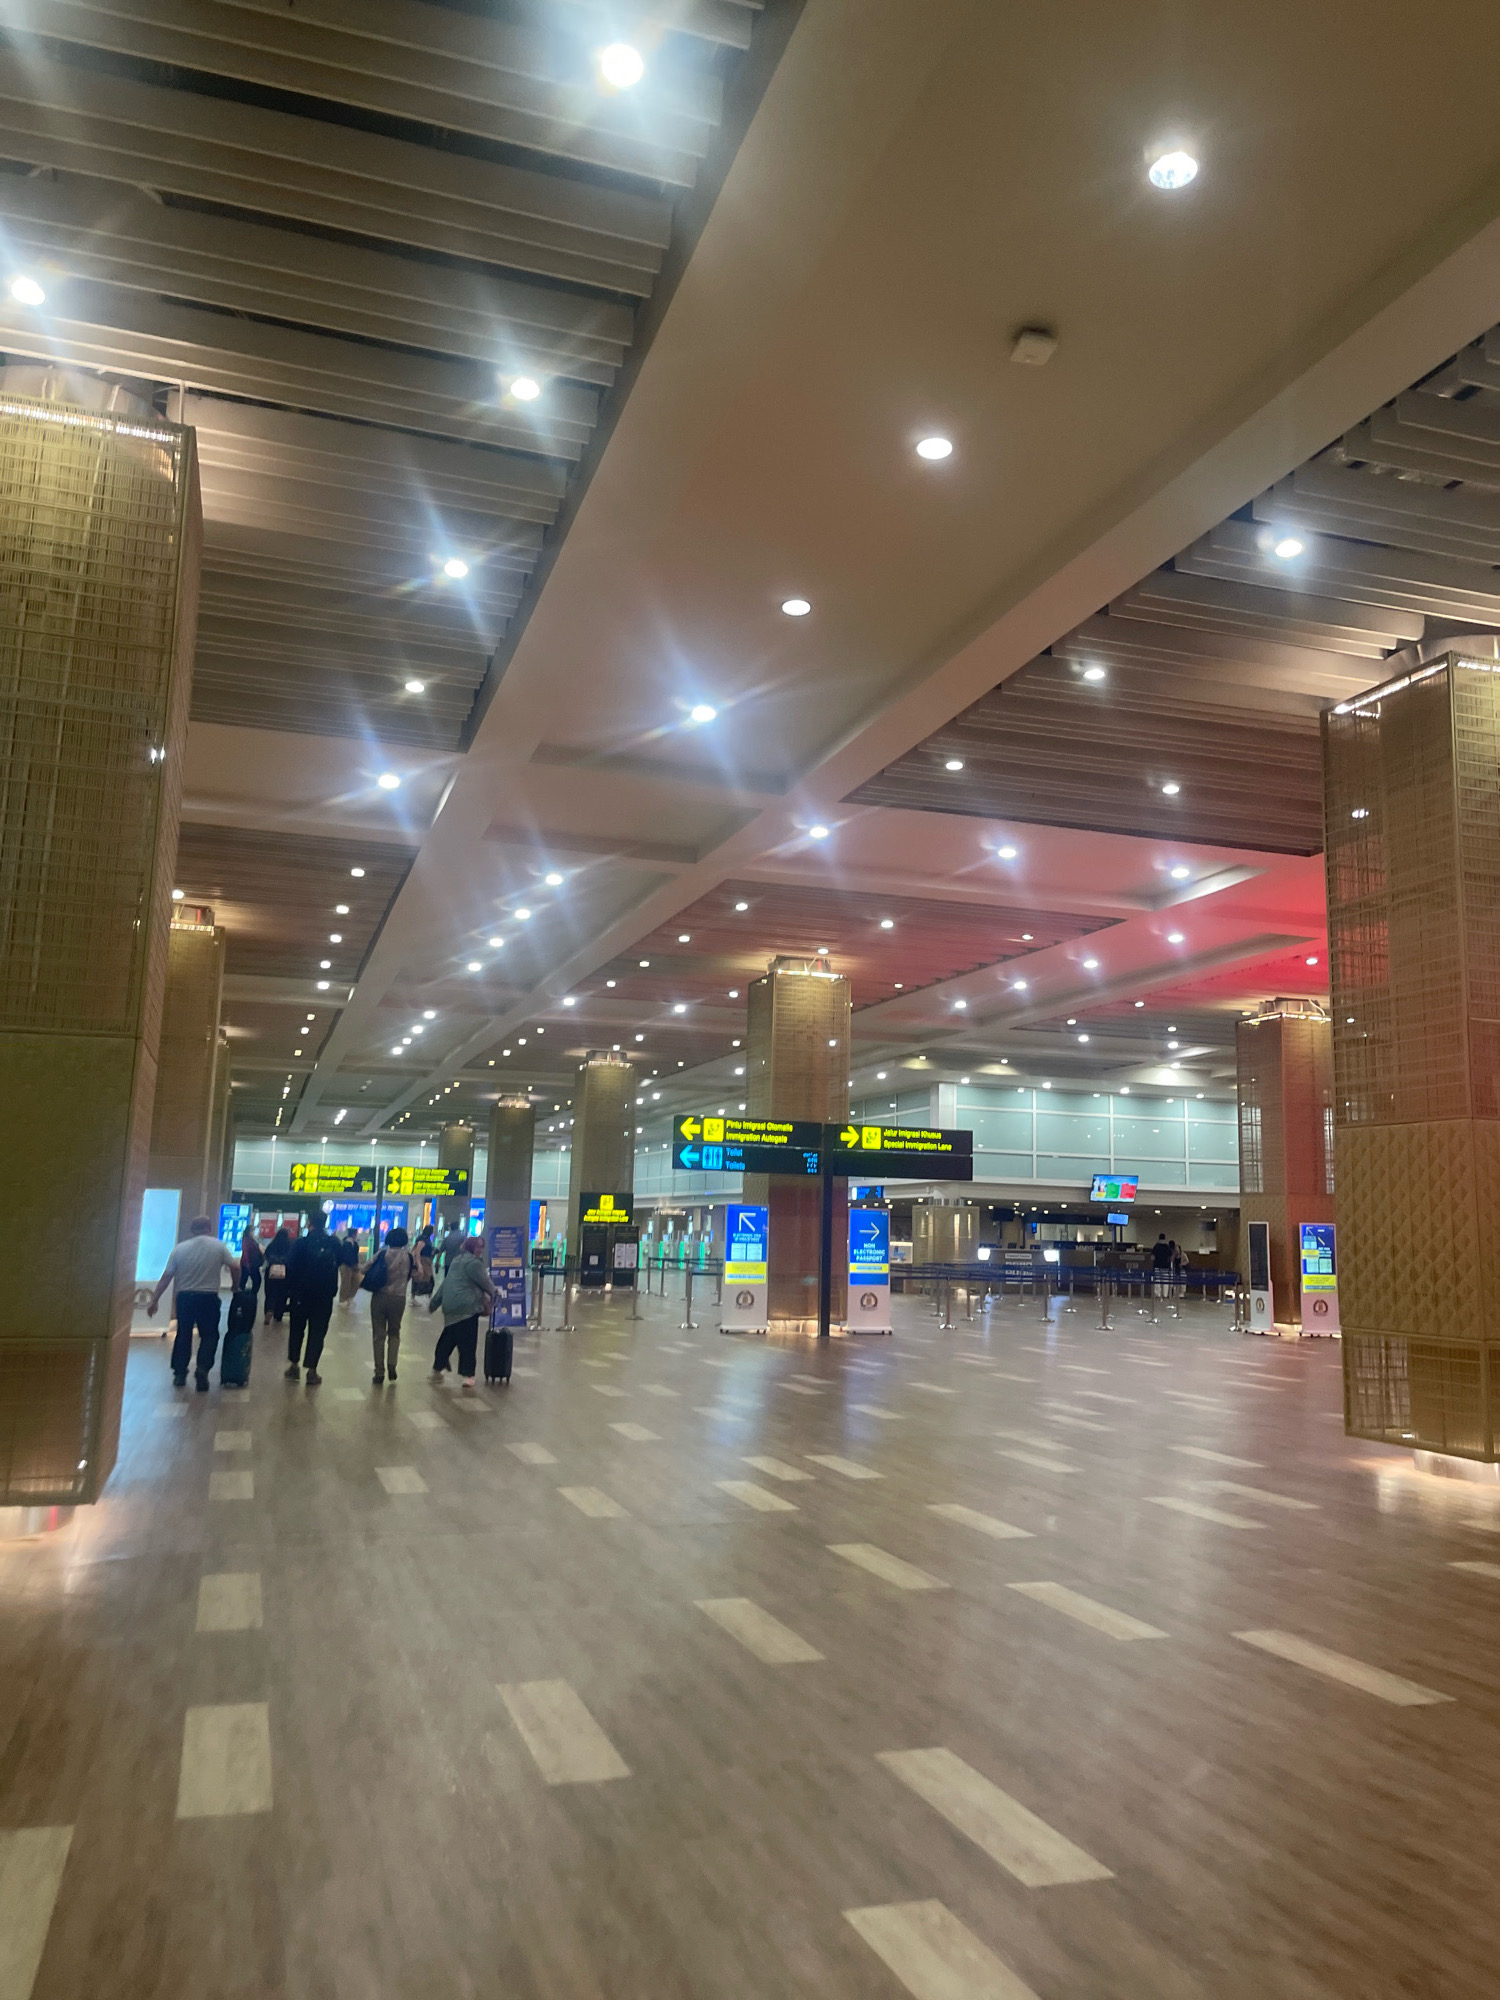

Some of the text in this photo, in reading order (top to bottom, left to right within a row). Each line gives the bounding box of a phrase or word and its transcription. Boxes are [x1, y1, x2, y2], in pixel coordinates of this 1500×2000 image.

[743, 1121, 766, 1131] Imigrasi
[725, 1132, 760, 1142] Immigration
[883, 1139, 952, 1152] Special Immigration Lane
[853, 1248, 886, 1256] ELECTRONIC
